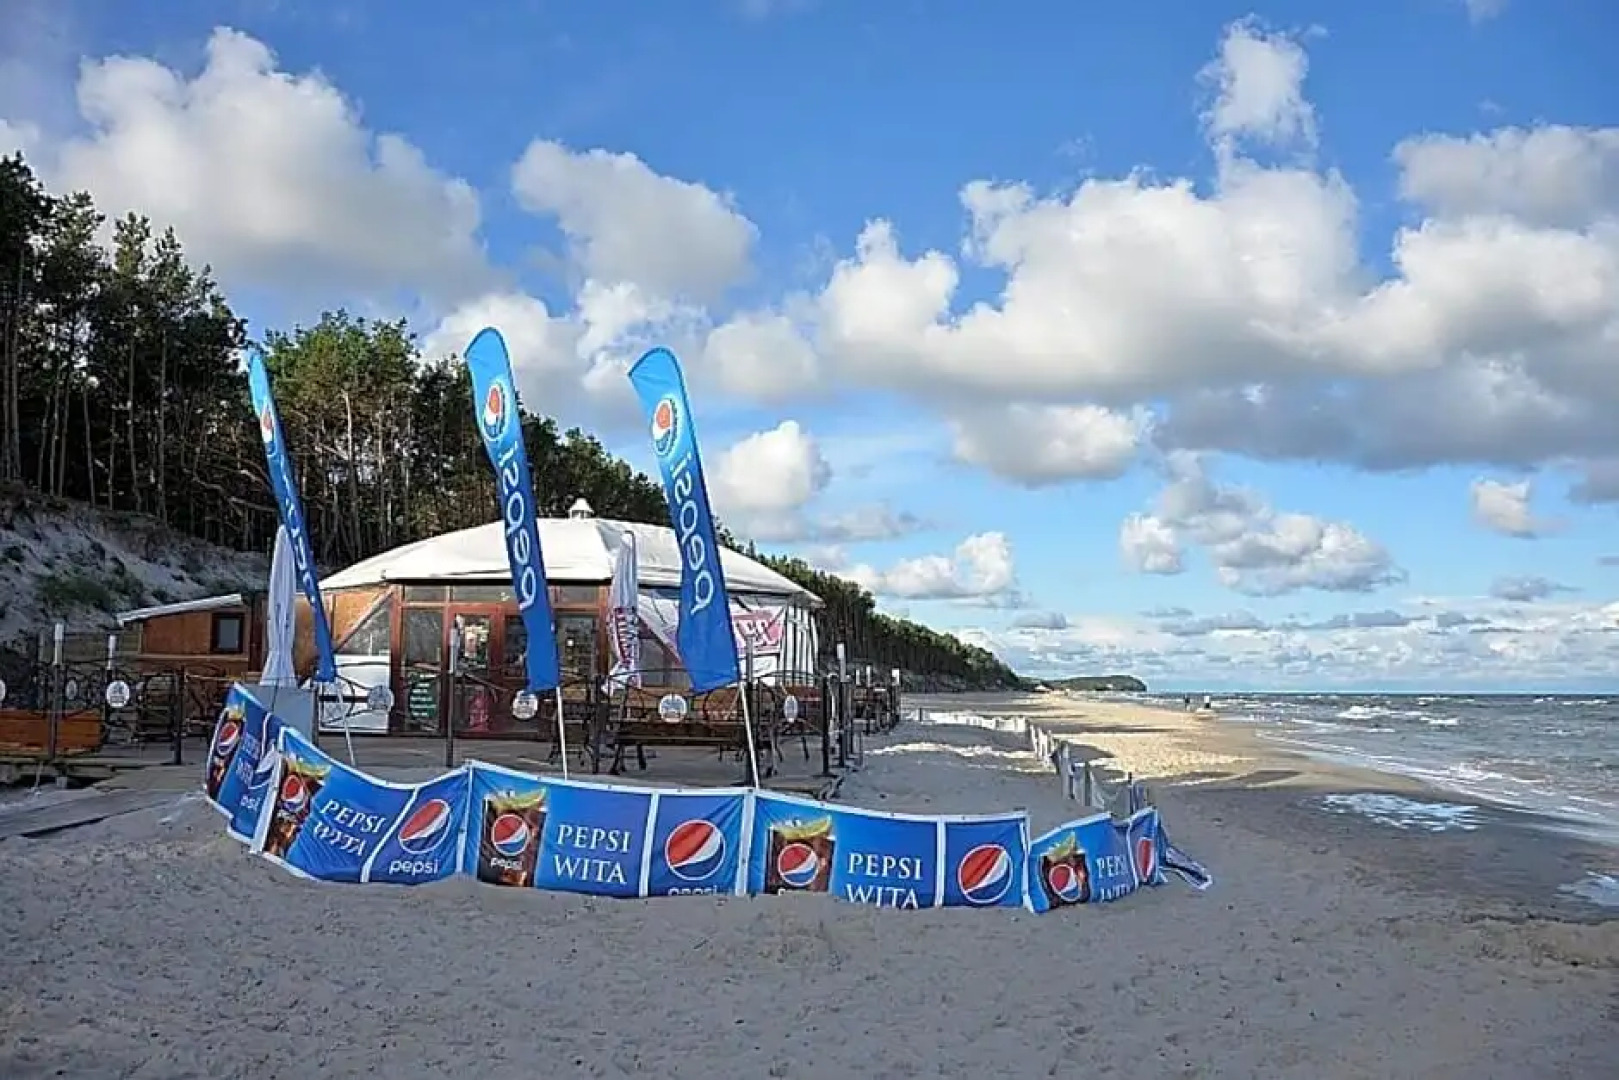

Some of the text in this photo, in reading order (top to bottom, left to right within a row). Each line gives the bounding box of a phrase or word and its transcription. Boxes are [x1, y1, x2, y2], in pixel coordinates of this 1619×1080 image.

[320, 798, 386, 834] PEPSI
[556, 823, 632, 854] PEPSI
[388, 857, 440, 877] pepsi
[553, 854, 628, 885] WITA
[847, 851, 923, 881] PEPSI
[845, 883, 920, 910] WITA
